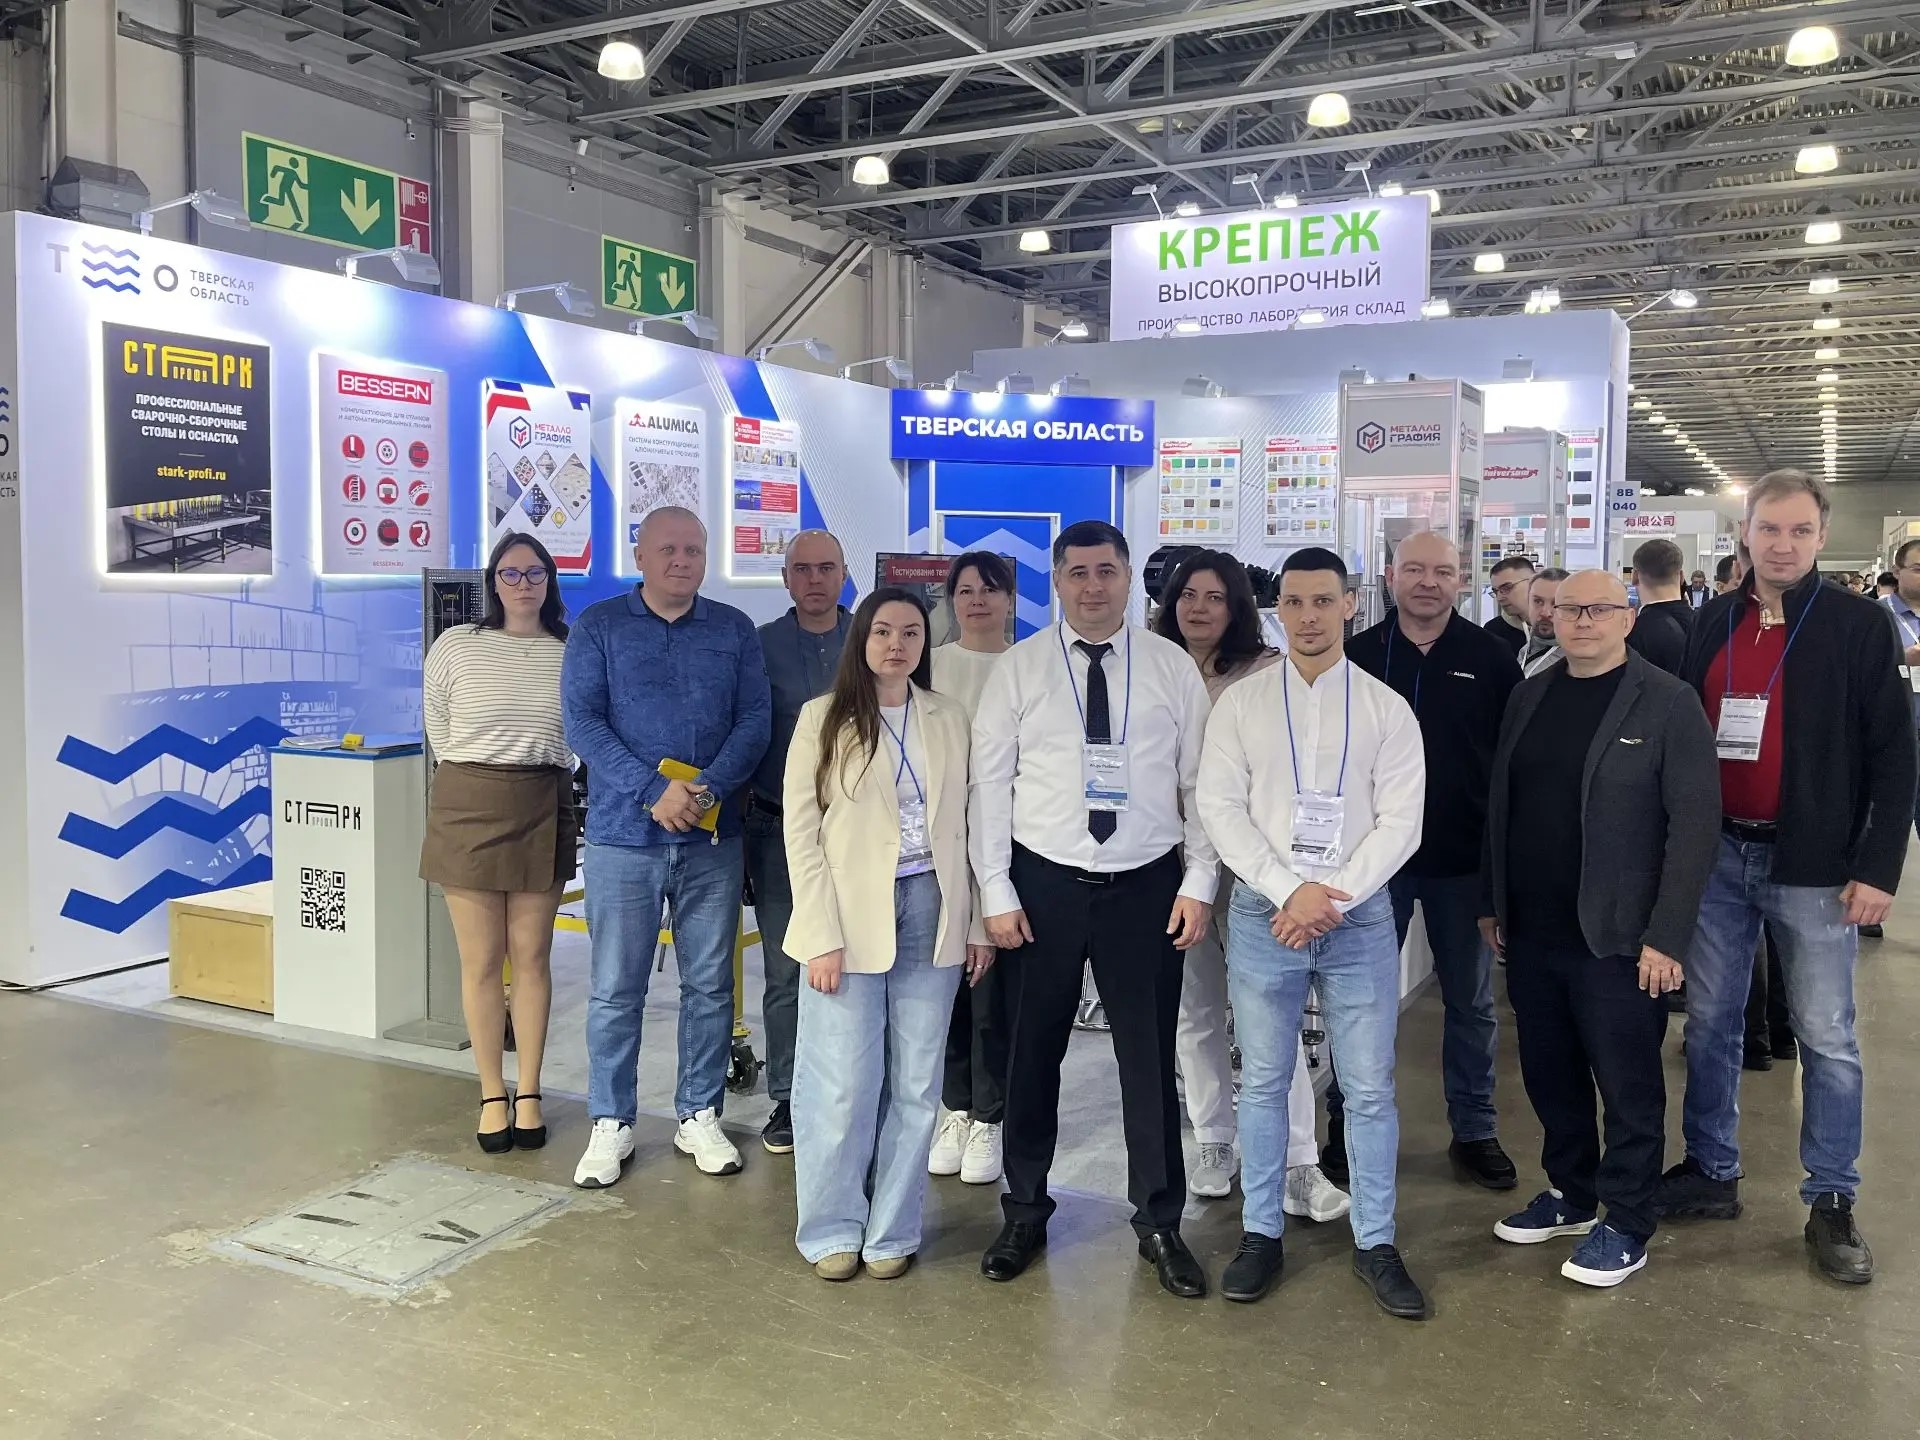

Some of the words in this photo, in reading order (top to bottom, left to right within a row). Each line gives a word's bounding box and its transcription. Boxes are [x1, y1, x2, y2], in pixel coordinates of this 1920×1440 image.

[1158, 208, 1382, 271] КРЕПЕЖ
[190, 269, 255, 292] ТВЕРСКАЯ
[1158, 261, 1381, 303] ВЫСОКОПРОЧНЫЙ
[190, 286, 250, 306] ОБЛАСТЬ
[1138, 311, 1243, 332] ПРОИДСТВО
[1249, 304, 1348, 325] ЛАБОРРИЯ
[1355, 300, 1406, 317] СКЛАД
[123, 340, 253, 389] СТАРК
[340, 374, 429, 401] BESSERN
[135, 393, 243, 416] ПРОФЕССИОНАЛЬНЫЕ
[131, 408, 248, 431] СВАРОЧНО-СБОРОЧНЫЕ
[534, 423, 572, 434] МЕТАЛЛО
[647, 415, 699, 435] ALUMICA
[900, 416, 1027, 439] ТВЕРСКАЯ
[1033, 421, 1144, 443] ОБЛАСТЬ
[1390, 424, 1441, 433] МЕТАЛЛО
[141, 425, 177, 439] СТОЛЫ
[178, 428, 186, 440] И
[187, 429, 239, 445] ОСНАСТКА
[534, 431, 572, 444] ГРАФИЯ
[1389, 432, 1441, 443] ГРАФИЯ
[156, 465, 227, 481] stark-profi.ru
[1616, 488, 1634, 497] 8B
[1612, 502, 1637, 511] 040
[1624, 515, 1675, 527] 有限公司
[891, 566, 935, 579] Тестирование
[284, 799, 362, 831] СТАРК
